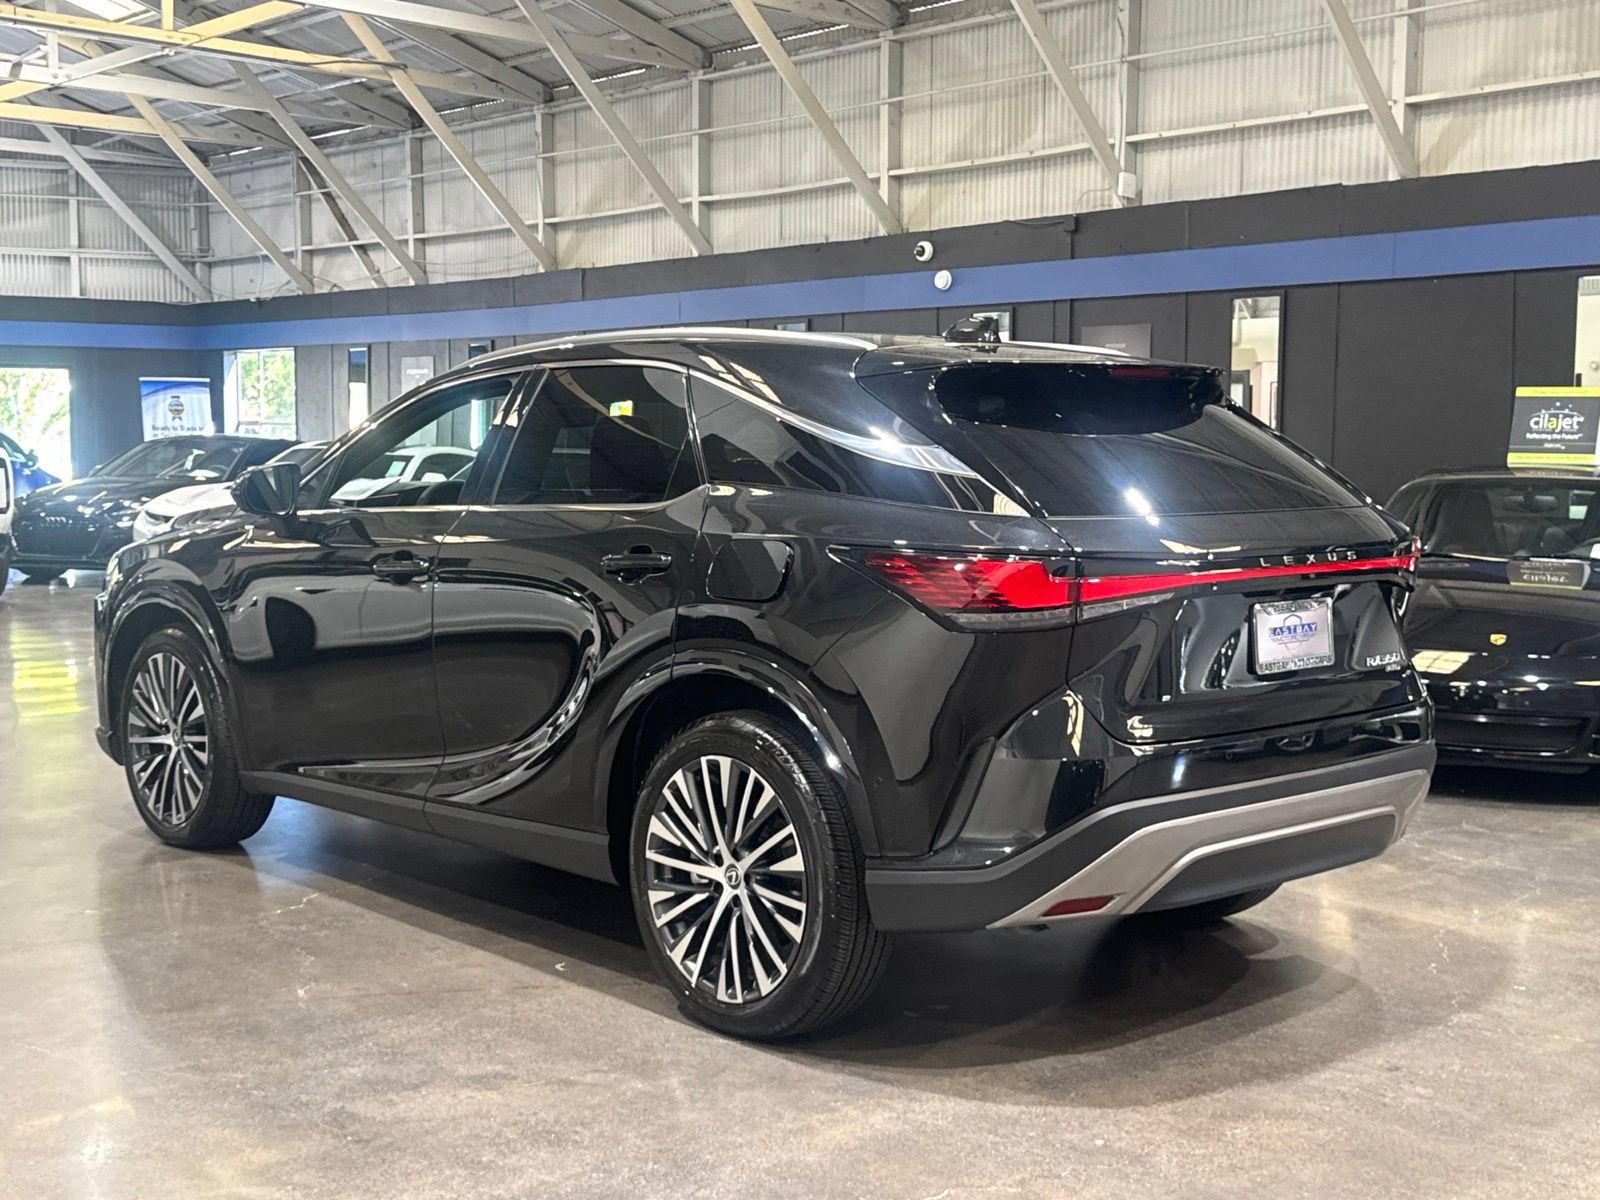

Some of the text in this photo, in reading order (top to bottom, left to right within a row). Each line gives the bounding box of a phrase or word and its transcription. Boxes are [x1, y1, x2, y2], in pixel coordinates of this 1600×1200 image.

[1529, 413, 1584, 433] cilajet
[1259, 551, 1357, 567] LEXUS
[1269, 622, 1318, 637] EASTBAY
